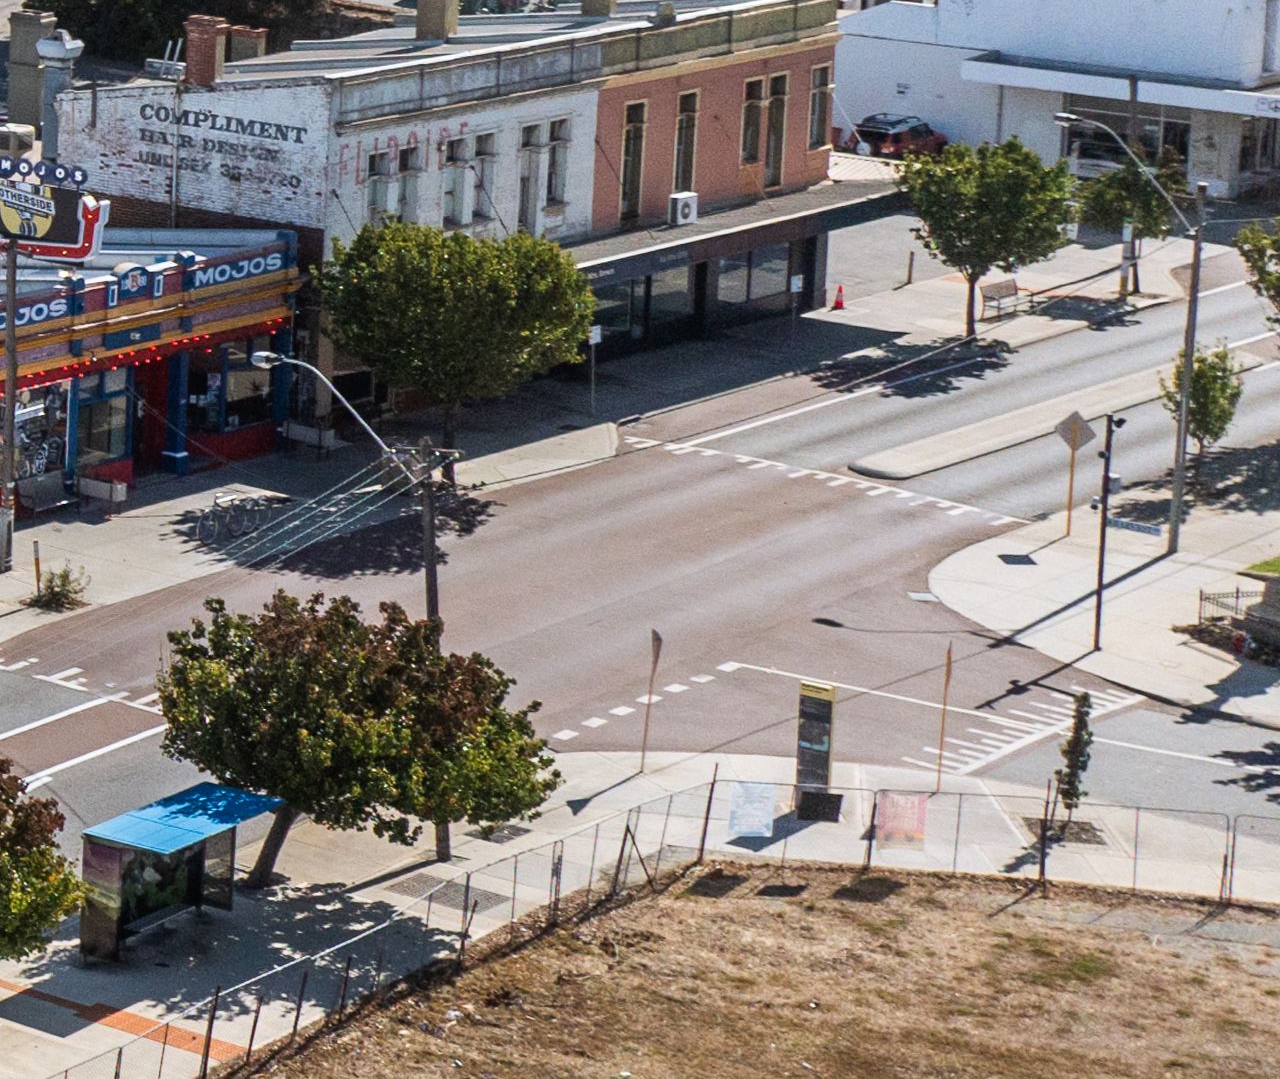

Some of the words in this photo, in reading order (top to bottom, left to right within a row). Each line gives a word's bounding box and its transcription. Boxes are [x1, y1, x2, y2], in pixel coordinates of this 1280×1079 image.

[140, 104, 308, 144] COMPLIMENT
[1, 159, 84, 181] MOJOS
[195, 252, 282, 287] MOJOS
